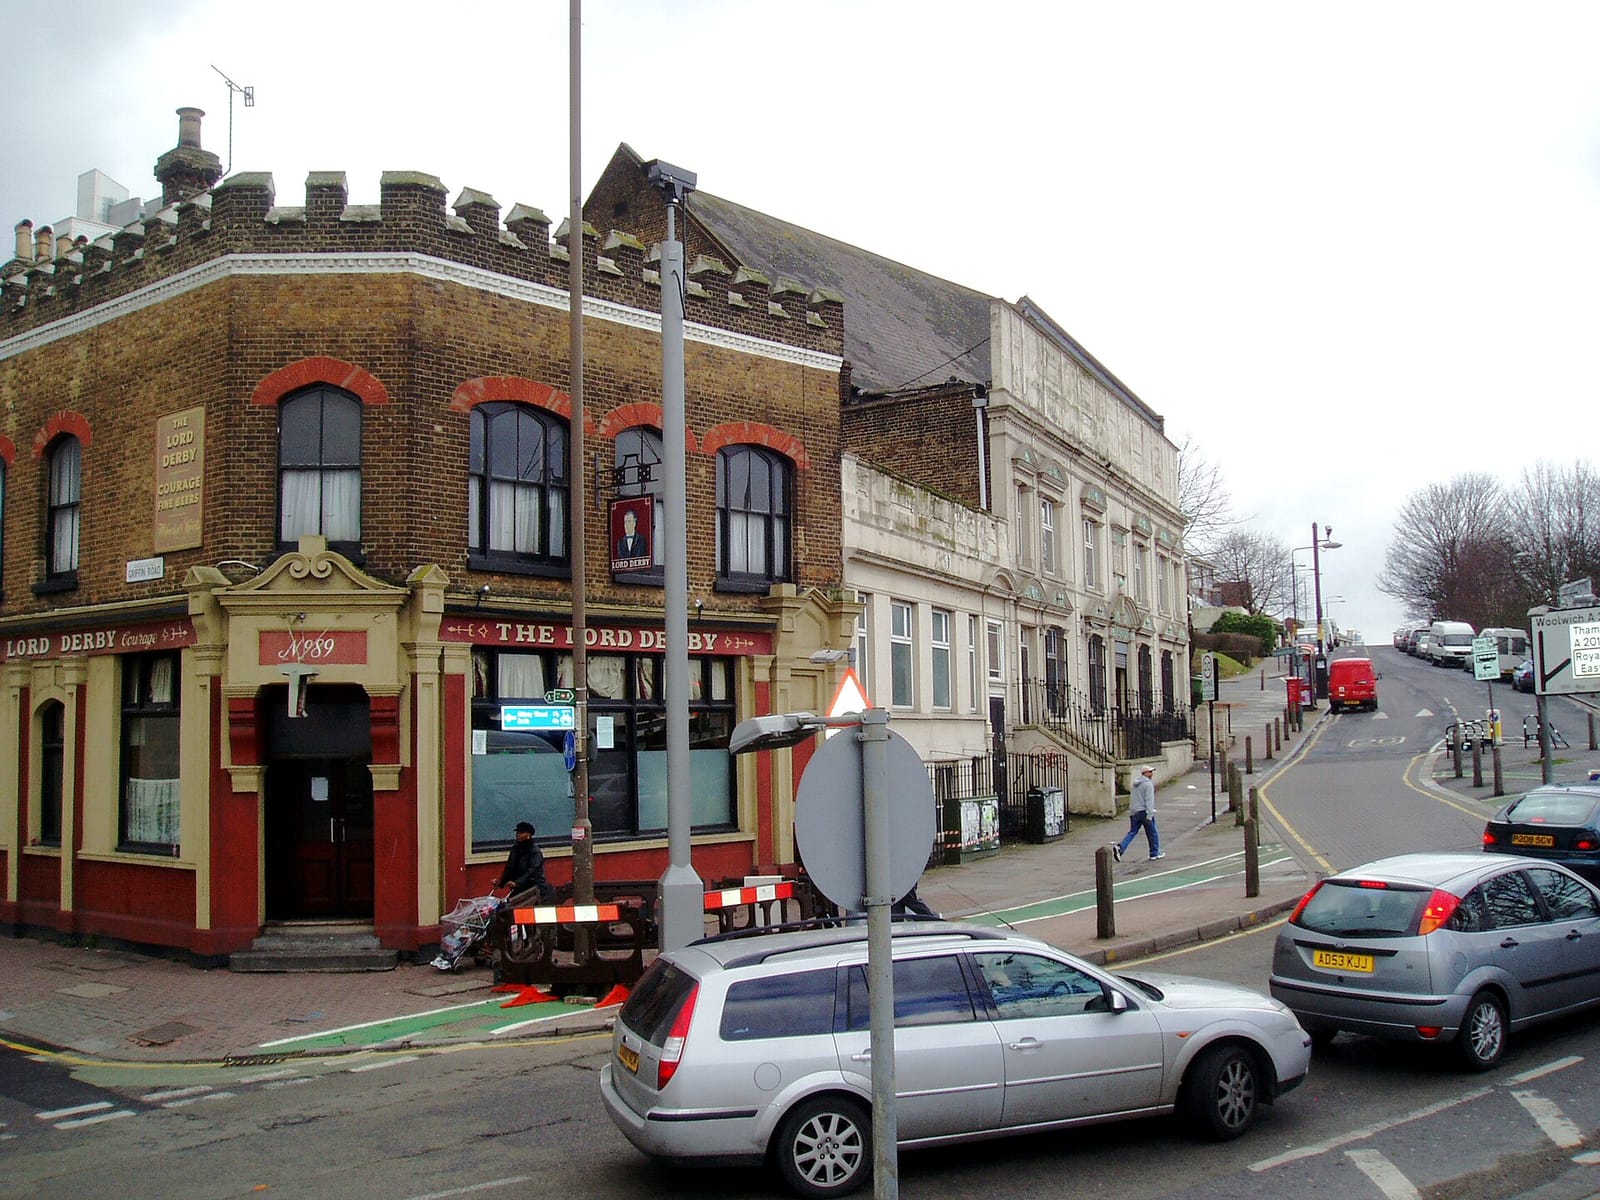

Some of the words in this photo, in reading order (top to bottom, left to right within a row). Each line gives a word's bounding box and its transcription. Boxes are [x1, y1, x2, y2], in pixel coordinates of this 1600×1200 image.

[173, 417, 188, 429] THE
[167, 431, 194, 449] LORD
[163, 448, 198, 468] DERBY
[158, 478, 201, 496] COURAGE
[612, 561, 628, 569] LORD
[1536, 613, 1584, 626] Woolwich
[7, 637, 50, 658] LORD
[61, 630, 117, 652] DERBY
[121, 631, 158, 650] Courage
[496, 623, 555, 644] THE
[639, 629, 718, 651] DEBY
[1575, 639, 1581, 647] A
[1318, 952, 1345, 967] AD53
[1346, 956, 1368, 969] KJJ
